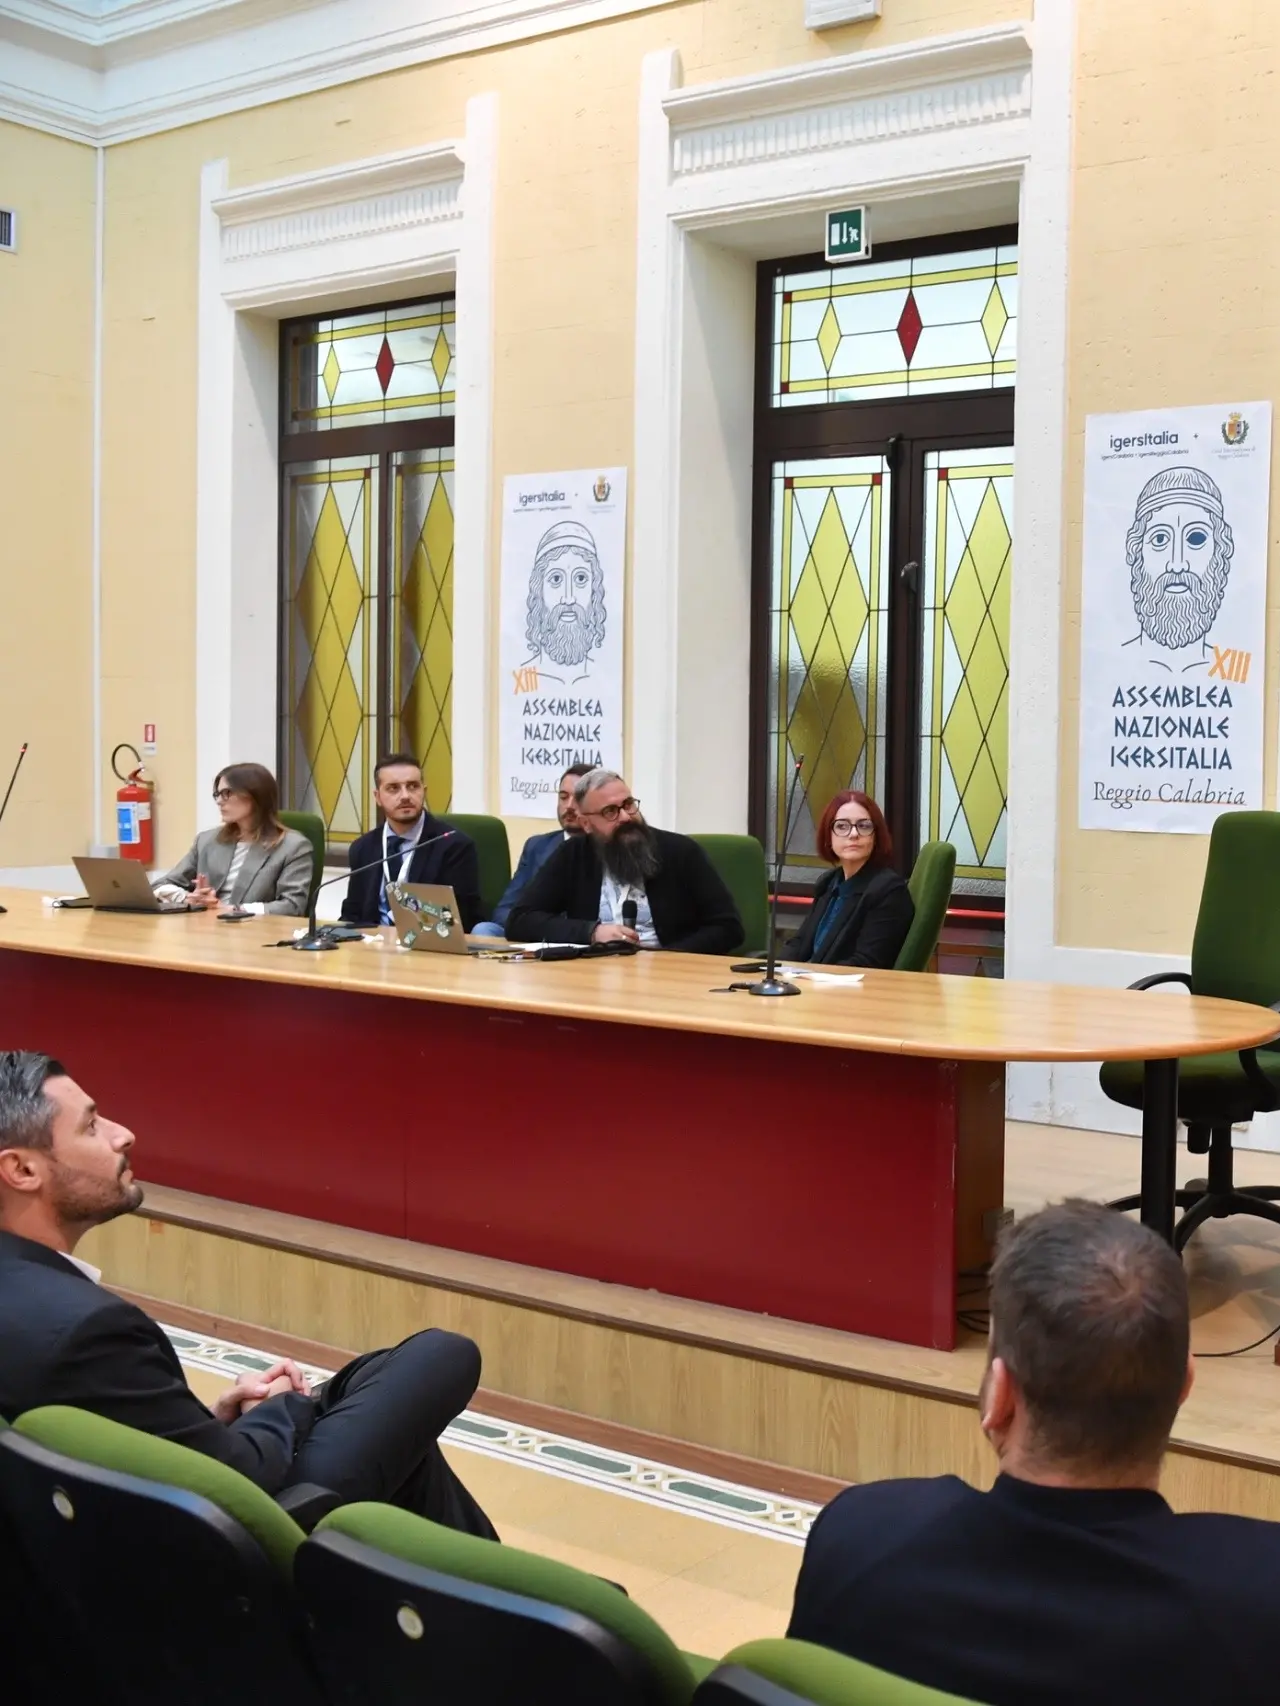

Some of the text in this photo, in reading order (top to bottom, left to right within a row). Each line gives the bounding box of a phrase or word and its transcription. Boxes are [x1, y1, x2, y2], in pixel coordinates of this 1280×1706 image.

[1109, 431, 1179, 451] igersItalia
[519, 490, 566, 506] igersItalia
[1208, 645, 1252, 684] XIII
[512, 666, 539, 696] XIII
[522, 698, 603, 717] ASSEMBLEA
[1112, 685, 1233, 708] ASSEMBLEA
[524, 723, 601, 742] NAZIONALE
[1114, 716, 1229, 739] NAZIONALE
[1110, 746, 1233, 770] IGERSITALIA
[510, 776, 550, 800] Reggio
[1093, 778, 1245, 809] Reggio Calabria
